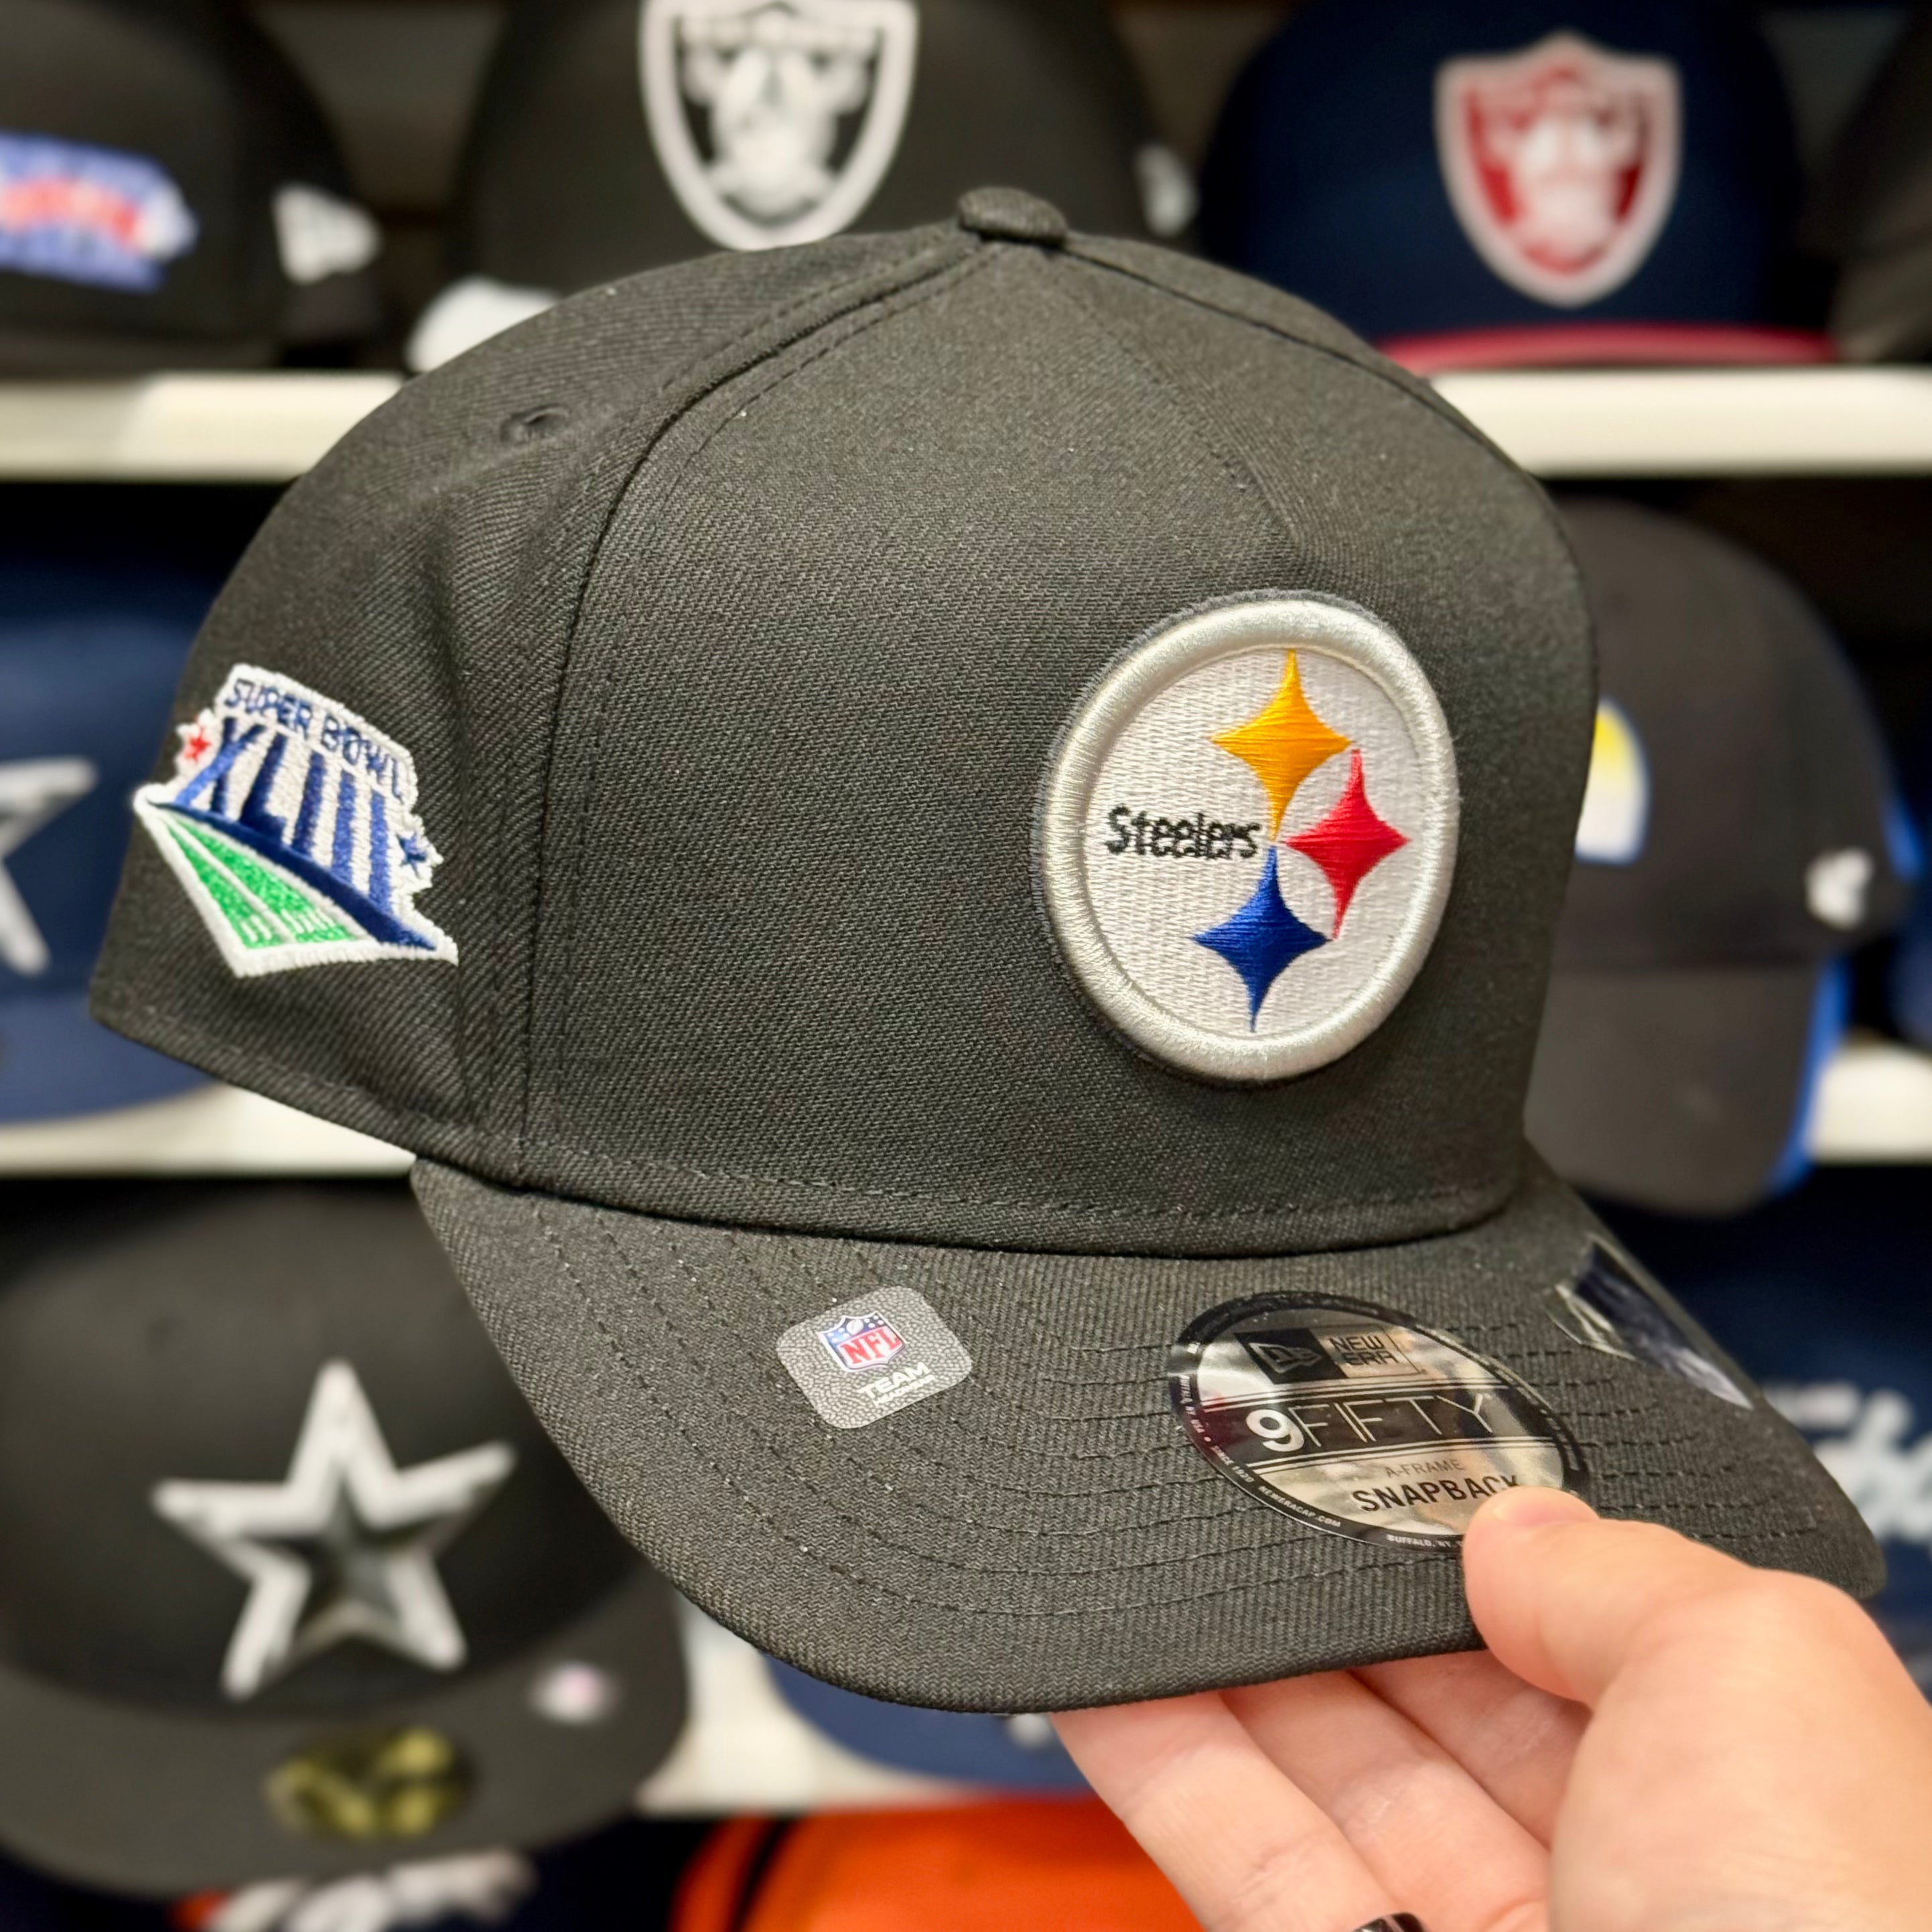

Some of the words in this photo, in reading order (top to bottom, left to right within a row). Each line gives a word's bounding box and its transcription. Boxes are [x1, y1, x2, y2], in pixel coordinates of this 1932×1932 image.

[224, 678, 313, 740] SUPER
[320, 713, 406, 805] BOWL
[173, 715, 394, 919] XLIII
[1105, 803, 1261, 860] Steelers
[840, 1328, 903, 1365] NFL
[1329, 1333, 1386, 1351] NEW
[1340, 1349, 1399, 1365] ERA
[857, 1362, 930, 1399] TEAM
[1245, 1393, 1493, 1452] 9FIFTY
[1231, 1466, 1255, 1483] 1920
[1385, 1459, 1466, 1477] A-FRAME
